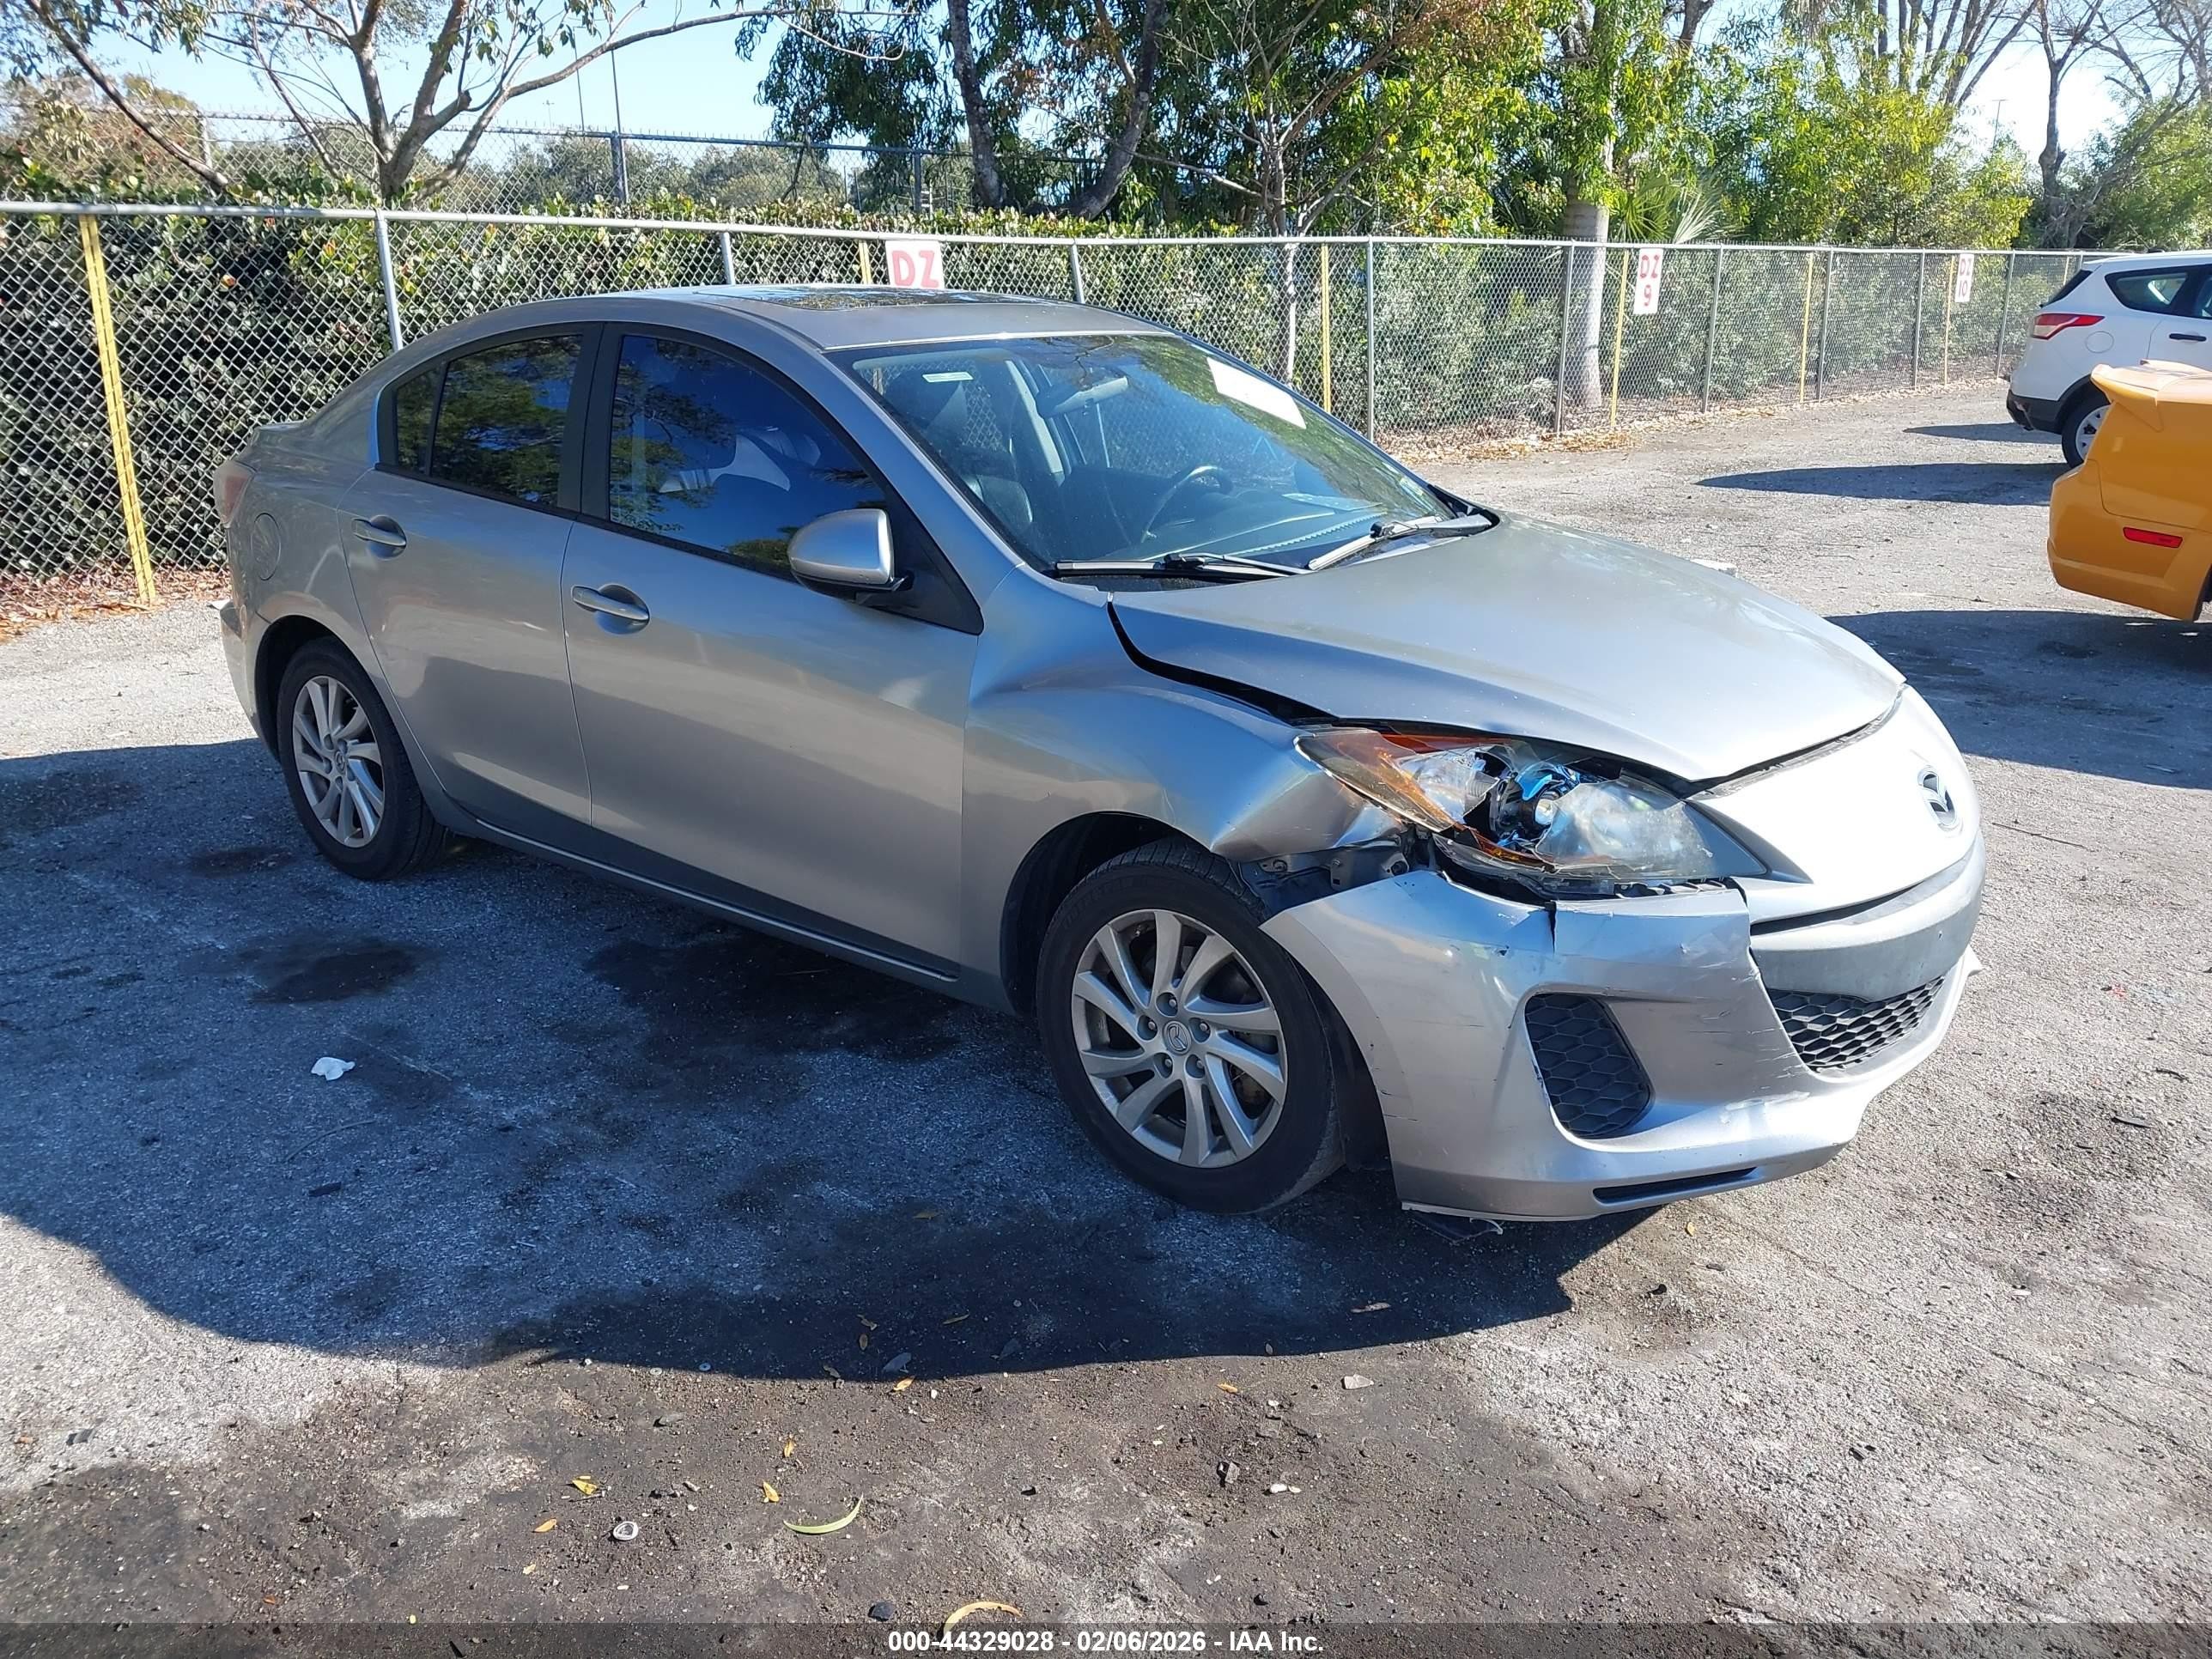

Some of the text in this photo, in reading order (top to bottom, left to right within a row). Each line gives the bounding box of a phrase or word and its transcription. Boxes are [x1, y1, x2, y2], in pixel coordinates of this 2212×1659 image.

[891, 250, 939, 289] DZ
[1639, 255, 1660, 278] DZ
[1644, 284, 1652, 307] 9
[1959, 280, 1968, 297] 10
